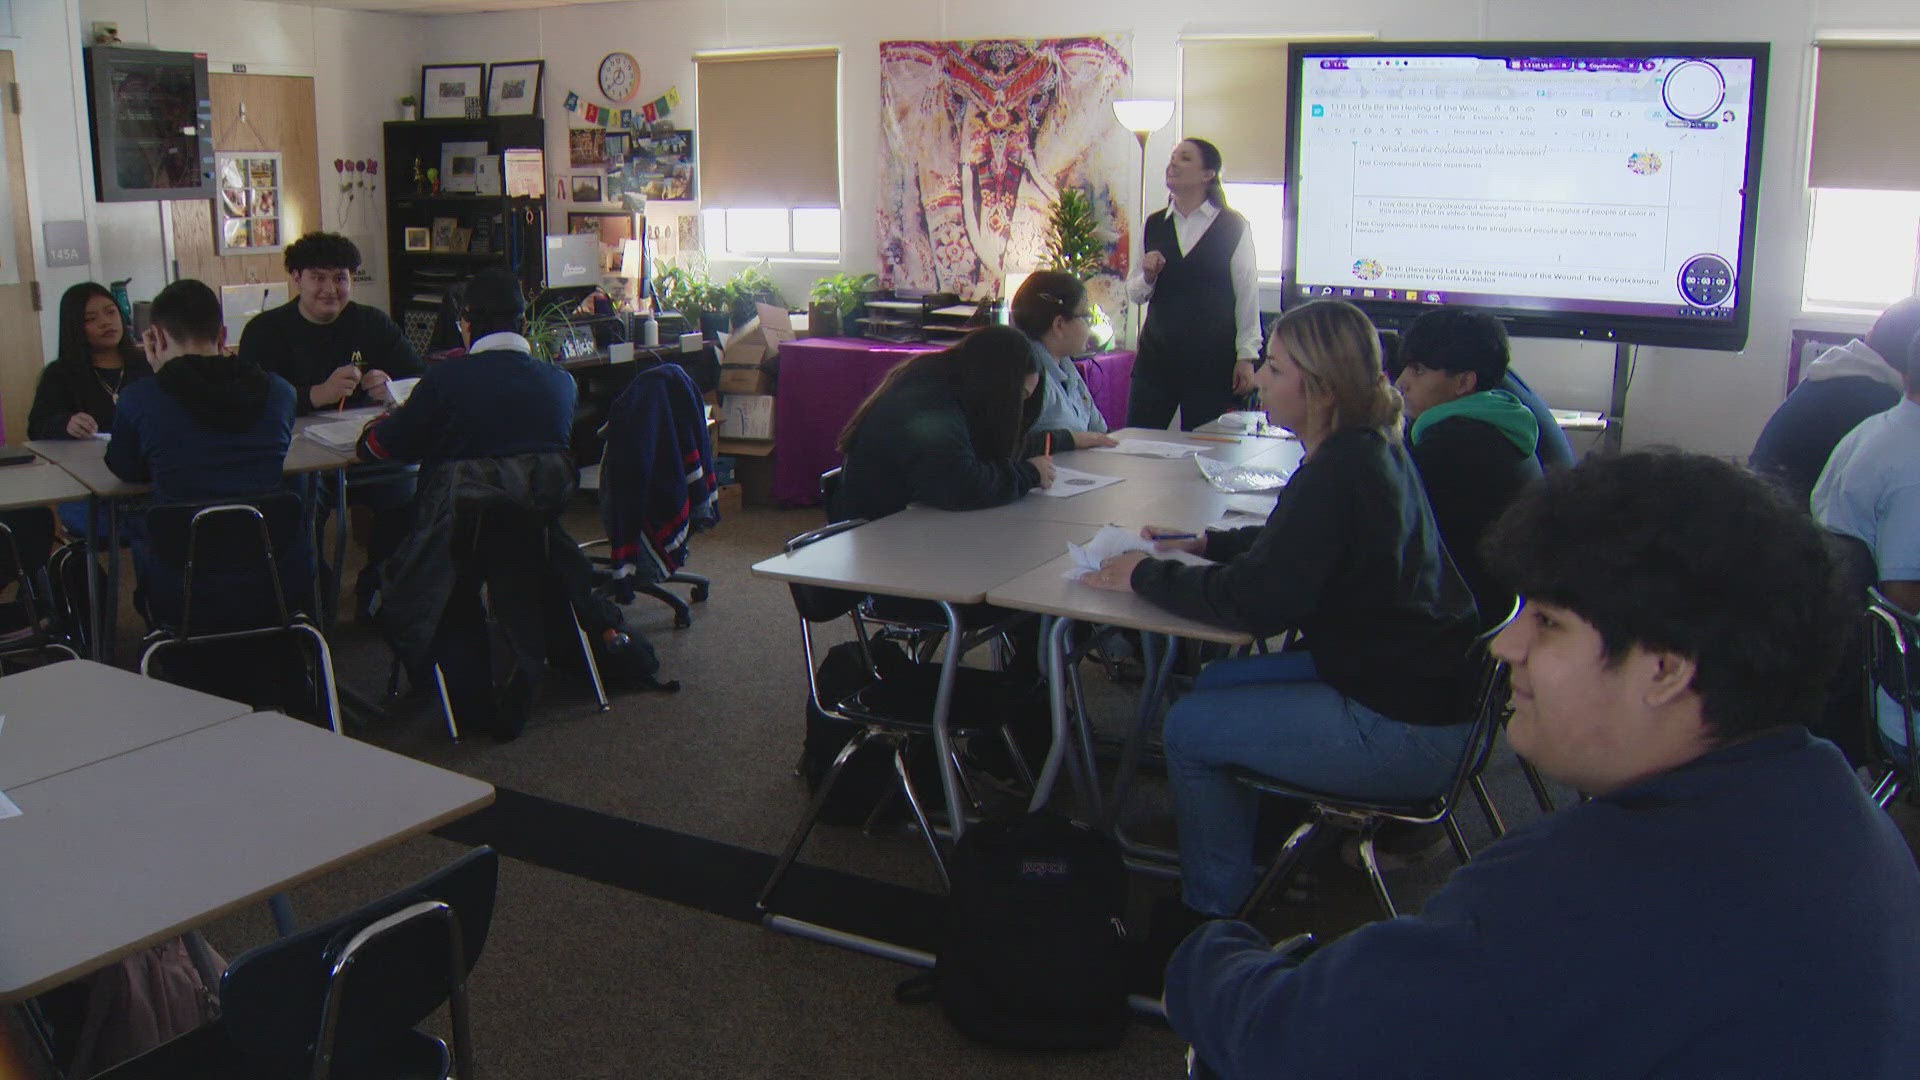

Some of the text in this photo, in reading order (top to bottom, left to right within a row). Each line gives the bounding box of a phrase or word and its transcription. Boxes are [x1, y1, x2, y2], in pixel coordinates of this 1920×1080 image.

[1401, 104, 1430, 113] Healing
[51, 249, 78, 260] 145A
[1405, 266, 1444, 274] (Revision)
[1498, 271, 1528, 279] Healing
